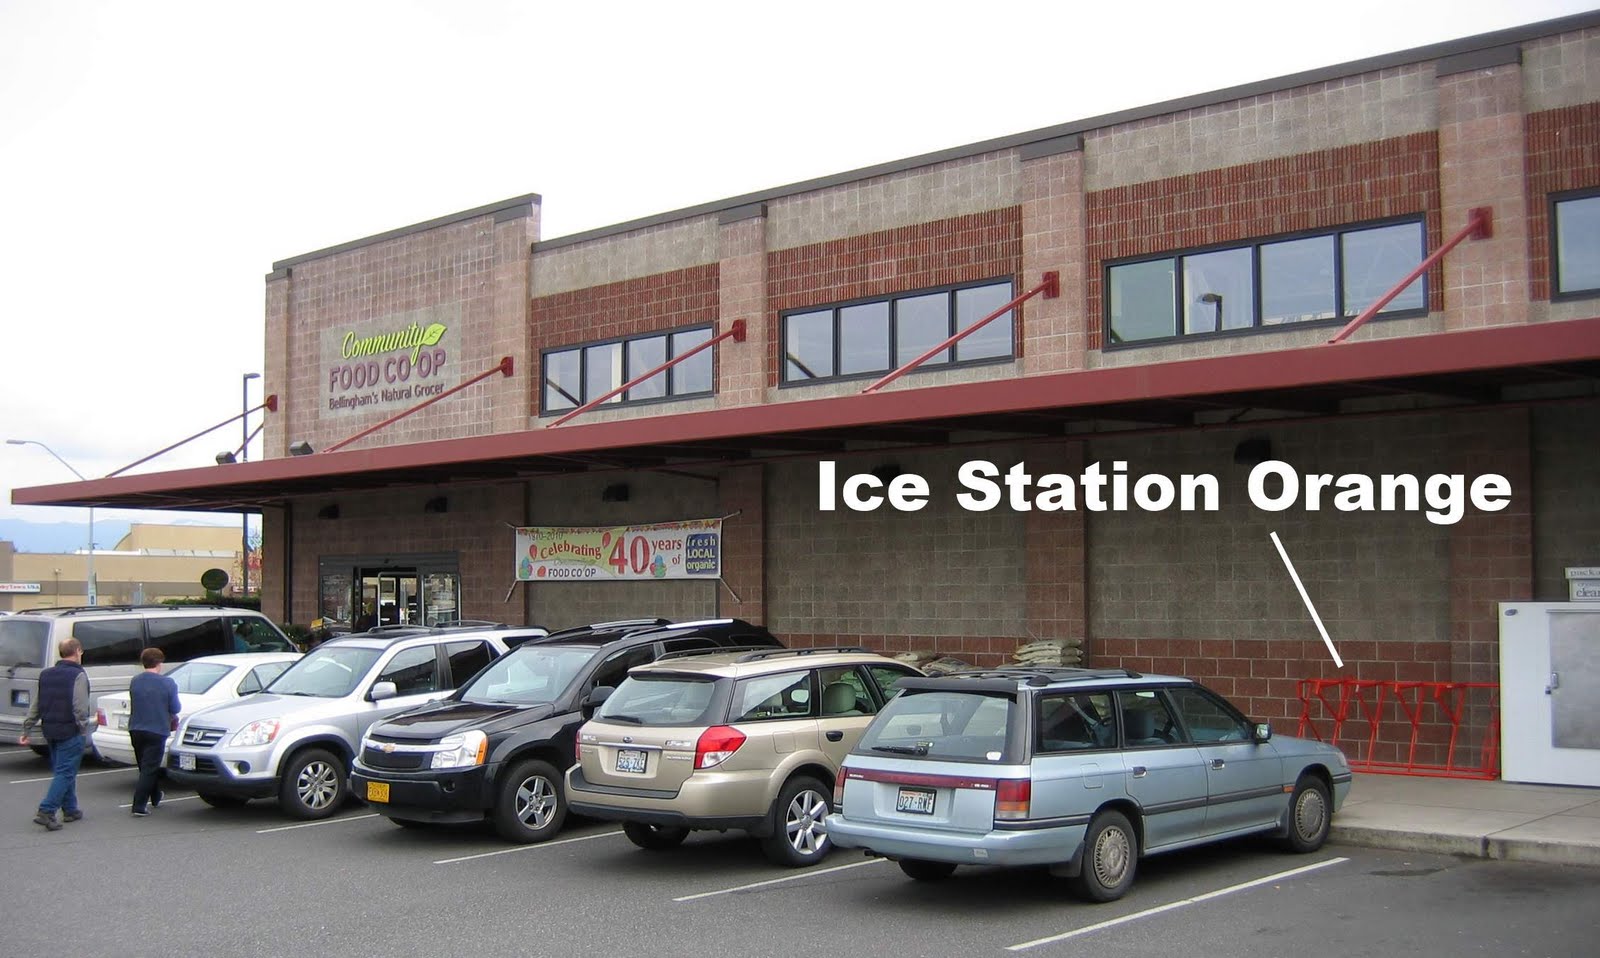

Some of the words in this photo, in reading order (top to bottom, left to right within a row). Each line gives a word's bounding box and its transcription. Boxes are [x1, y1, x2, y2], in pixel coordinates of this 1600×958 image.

[342, 321, 426, 366] Community
[329, 361, 380, 392] FOOD
[329, 391, 379, 410] Bellingham's
[381, 384, 412, 402] Natural
[414, 382, 445, 399] Grocer
[652, 538, 682, 555] years
[687, 536, 716, 547] fresh
[540, 540, 602, 560] Celebrating
[687, 548, 715, 558] LOCAL
[672, 553, 681, 565] of
[686, 559, 716, 571] organic
[548, 568, 570, 577] FOOD
